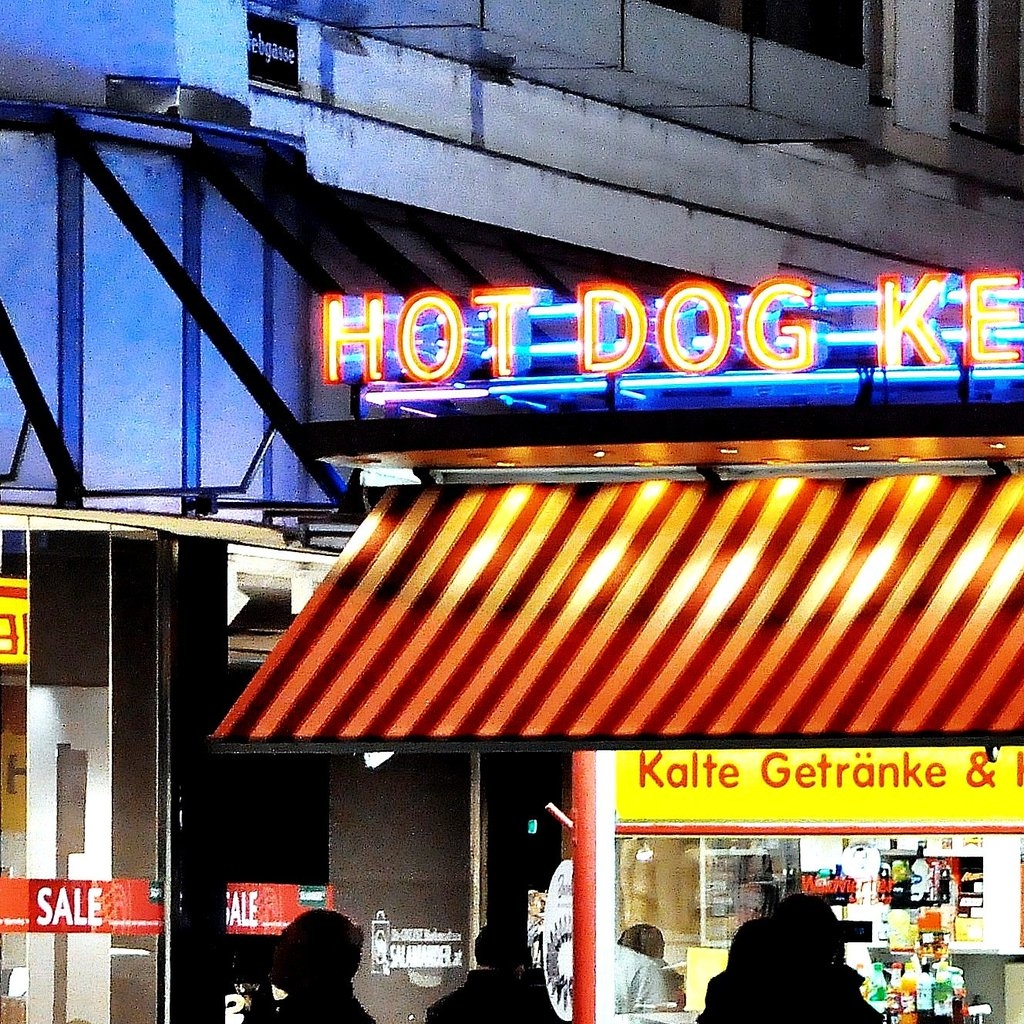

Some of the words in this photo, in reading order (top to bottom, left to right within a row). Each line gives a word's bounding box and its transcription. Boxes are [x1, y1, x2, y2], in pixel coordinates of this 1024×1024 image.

[323, 286, 534, 384] HOT
[578, 278, 815, 375] DOG
[639, 749, 740, 788] Kalte
[761, 751, 947, 788] Getränke
[966, 751, 996, 788] &
[36, 886, 103, 927] SALE
